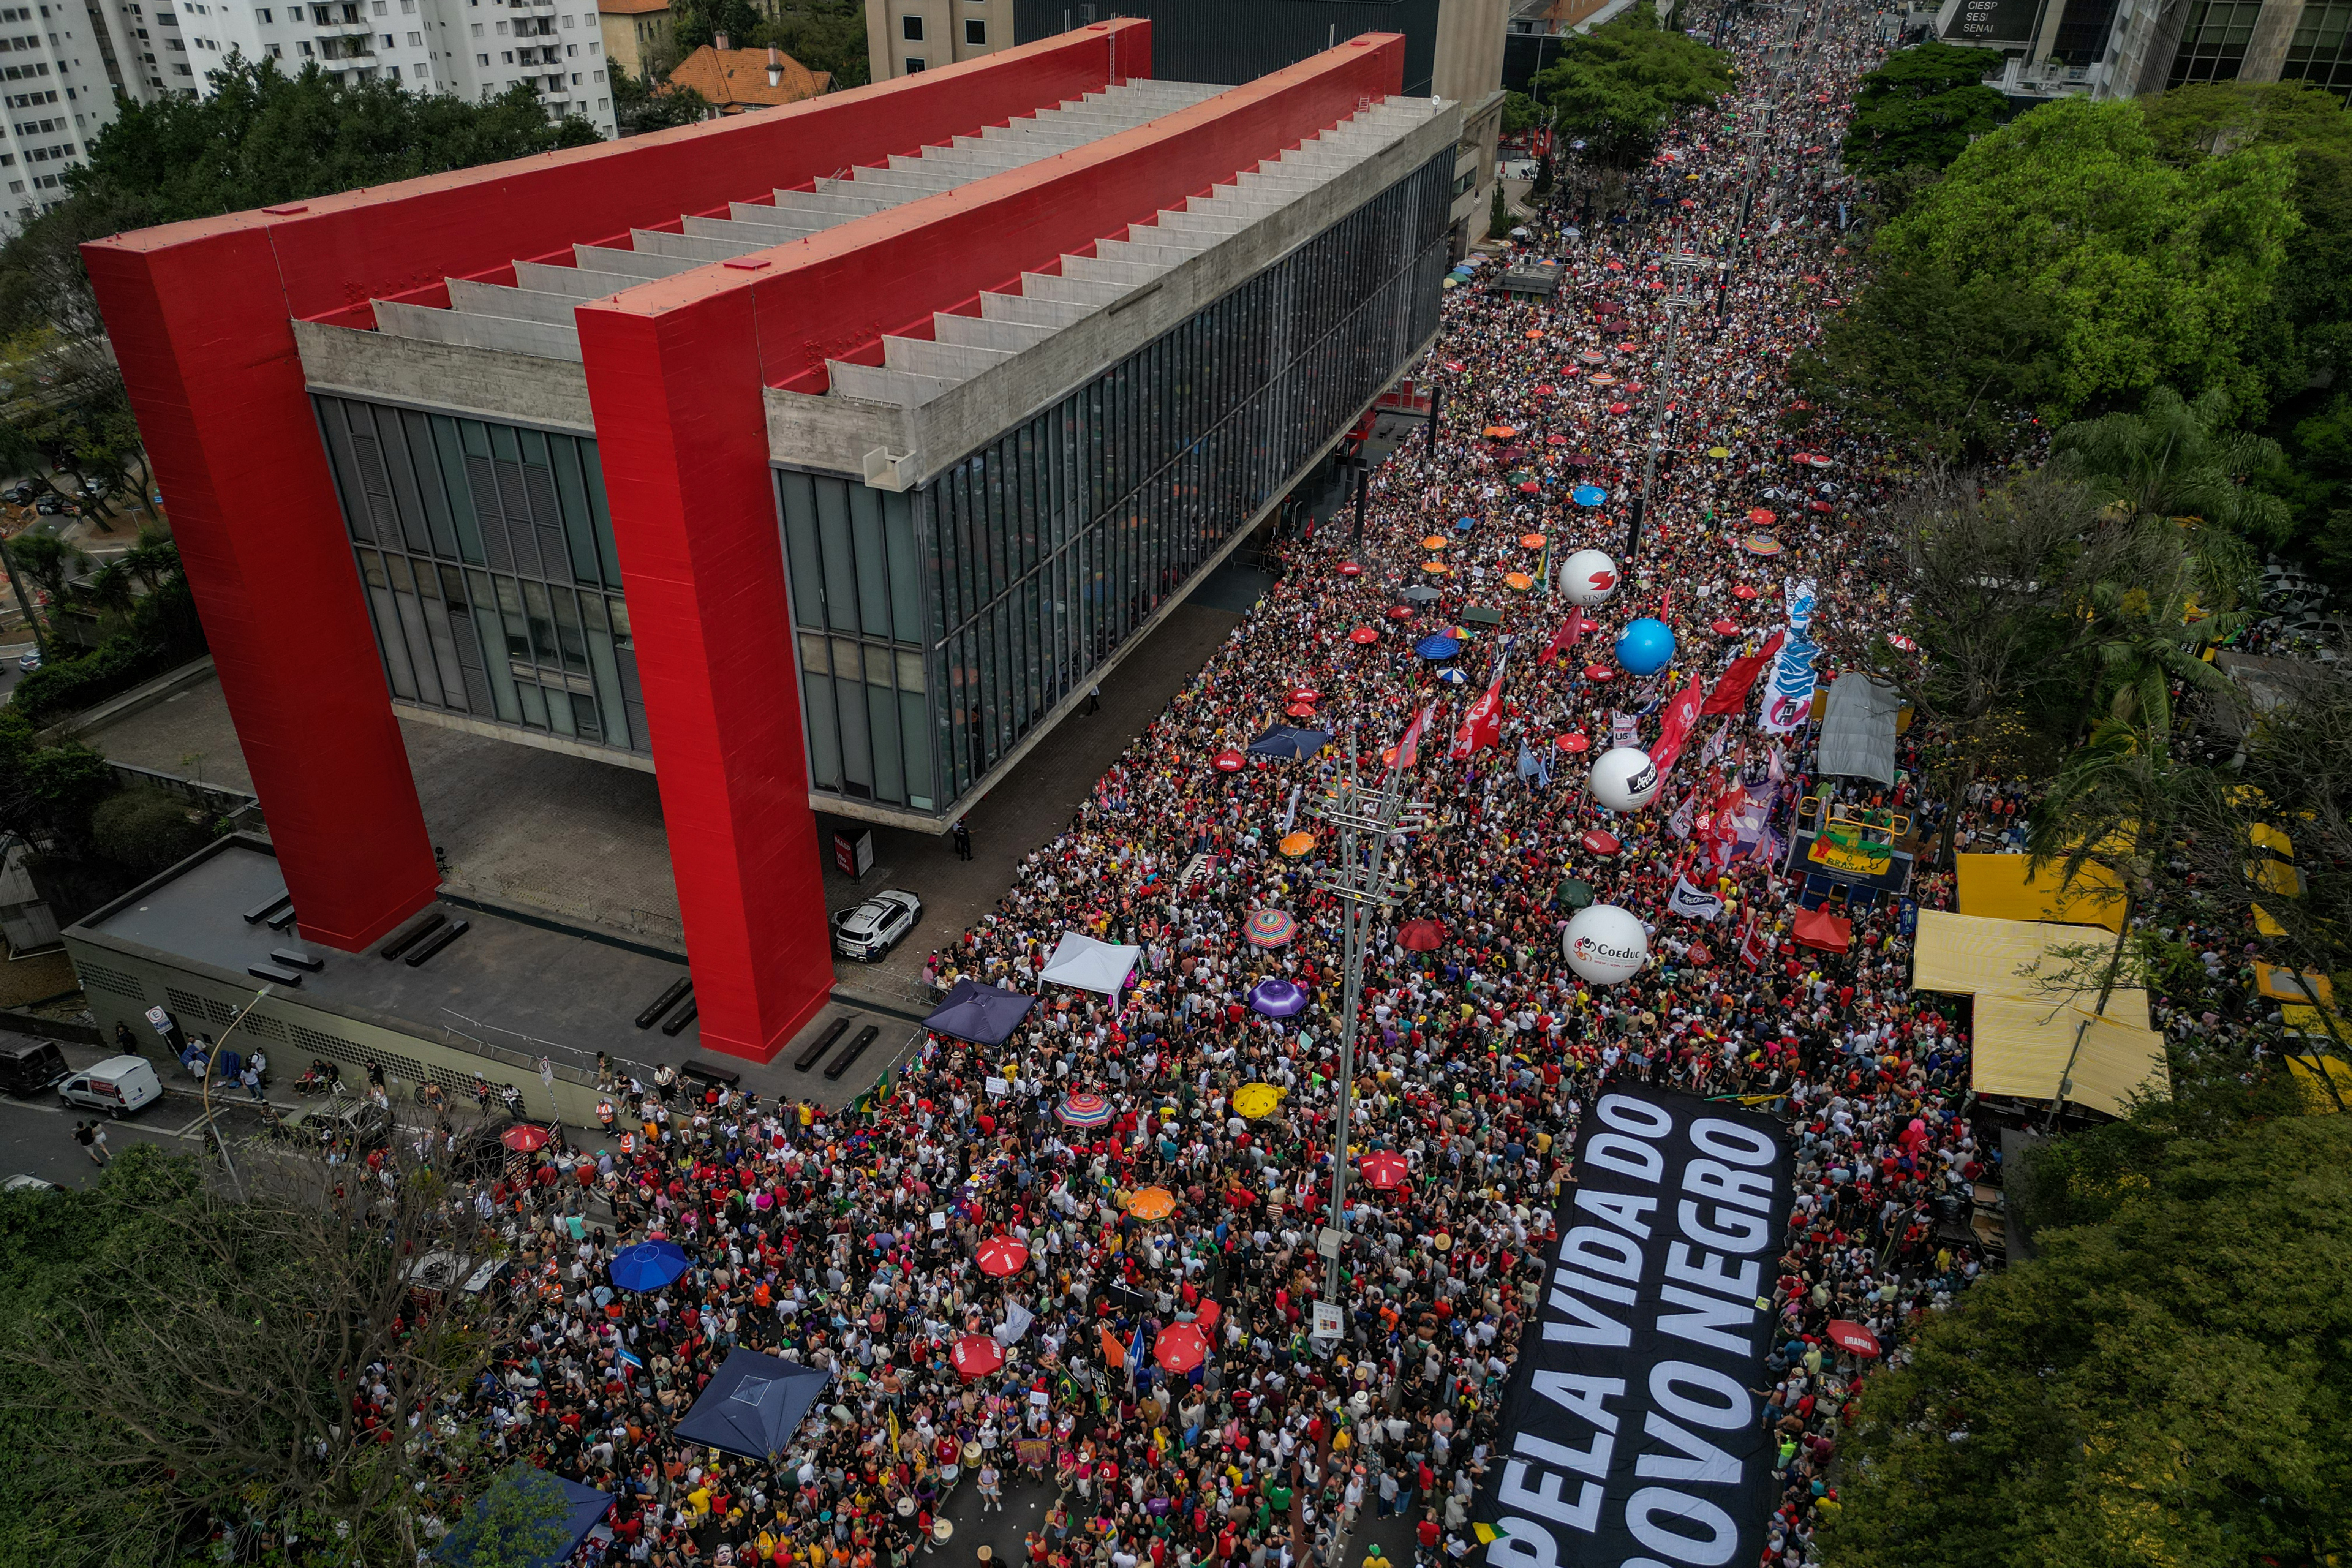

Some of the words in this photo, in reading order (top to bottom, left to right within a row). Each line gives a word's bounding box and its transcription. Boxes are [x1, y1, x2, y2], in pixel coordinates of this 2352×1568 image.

[1968, 1, 1998, 10] CIESP
[1966, 13, 1988, 21] SESI
[1963, 24, 1993, 33] SENAI
[835, 836, 851, 851] MASP
[899, 916, 909, 927] GCM
[1584, 1094, 1672, 1183] DO
[1656, 1118, 1775, 1357] NEGRO
[1543, 1189, 1657, 1347] VIDA
[1844, 1336, 1871, 1351] BRAHMA
[955, 1342, 966, 1365] BRAHMA
[1620, 1361, 1751, 1568] OVO
